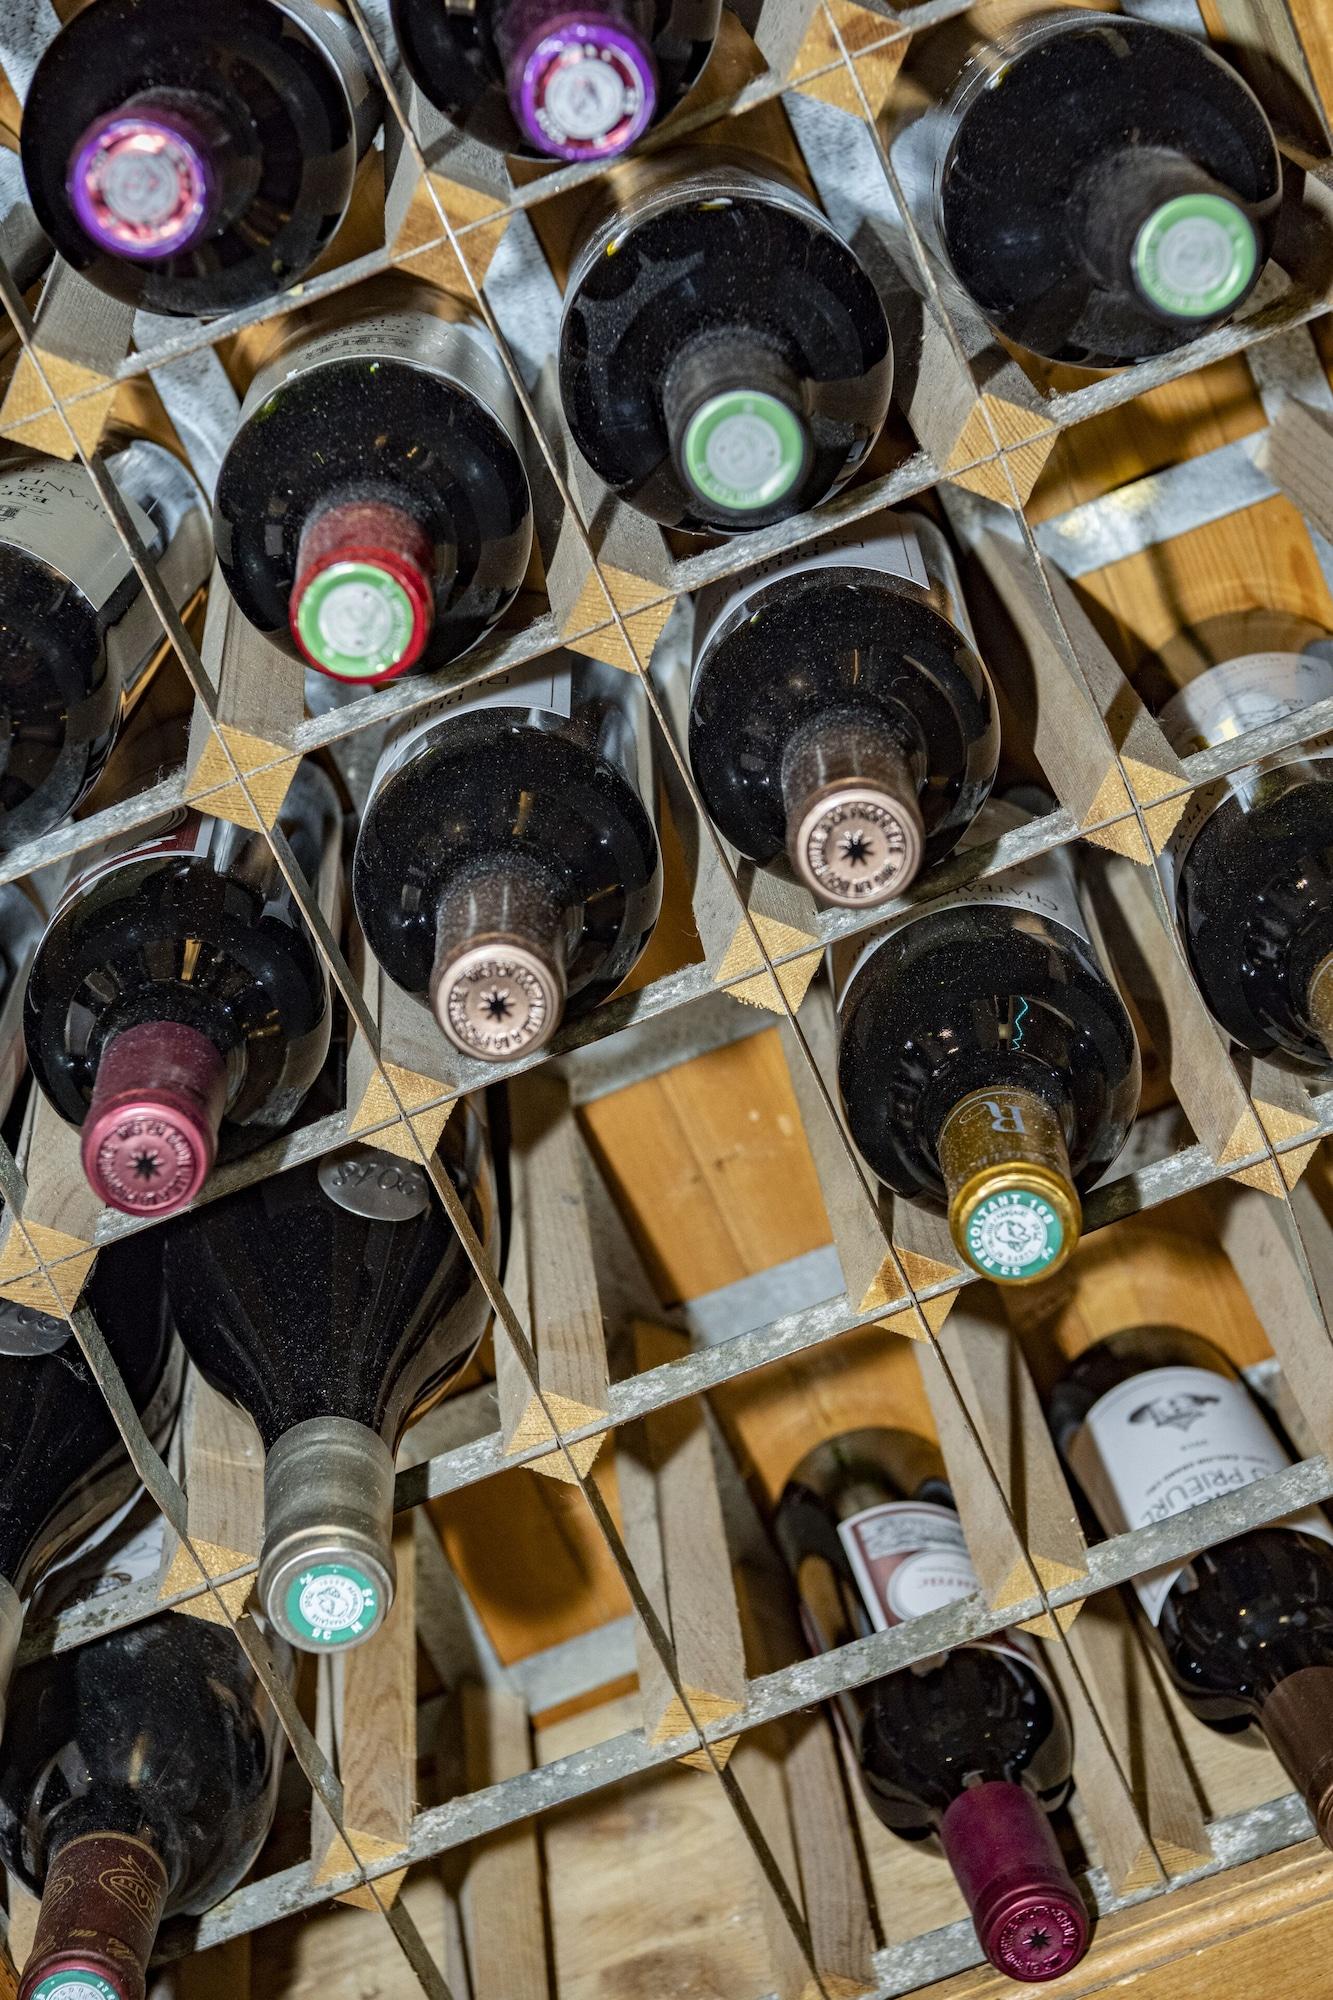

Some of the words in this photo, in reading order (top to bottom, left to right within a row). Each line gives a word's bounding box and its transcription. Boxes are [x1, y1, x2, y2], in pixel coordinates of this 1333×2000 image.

[982, 1101, 1026, 1133] R
[332, 1161, 421, 1196] 2018
[969, 1193, 1022, 1269] RECOLTANT
